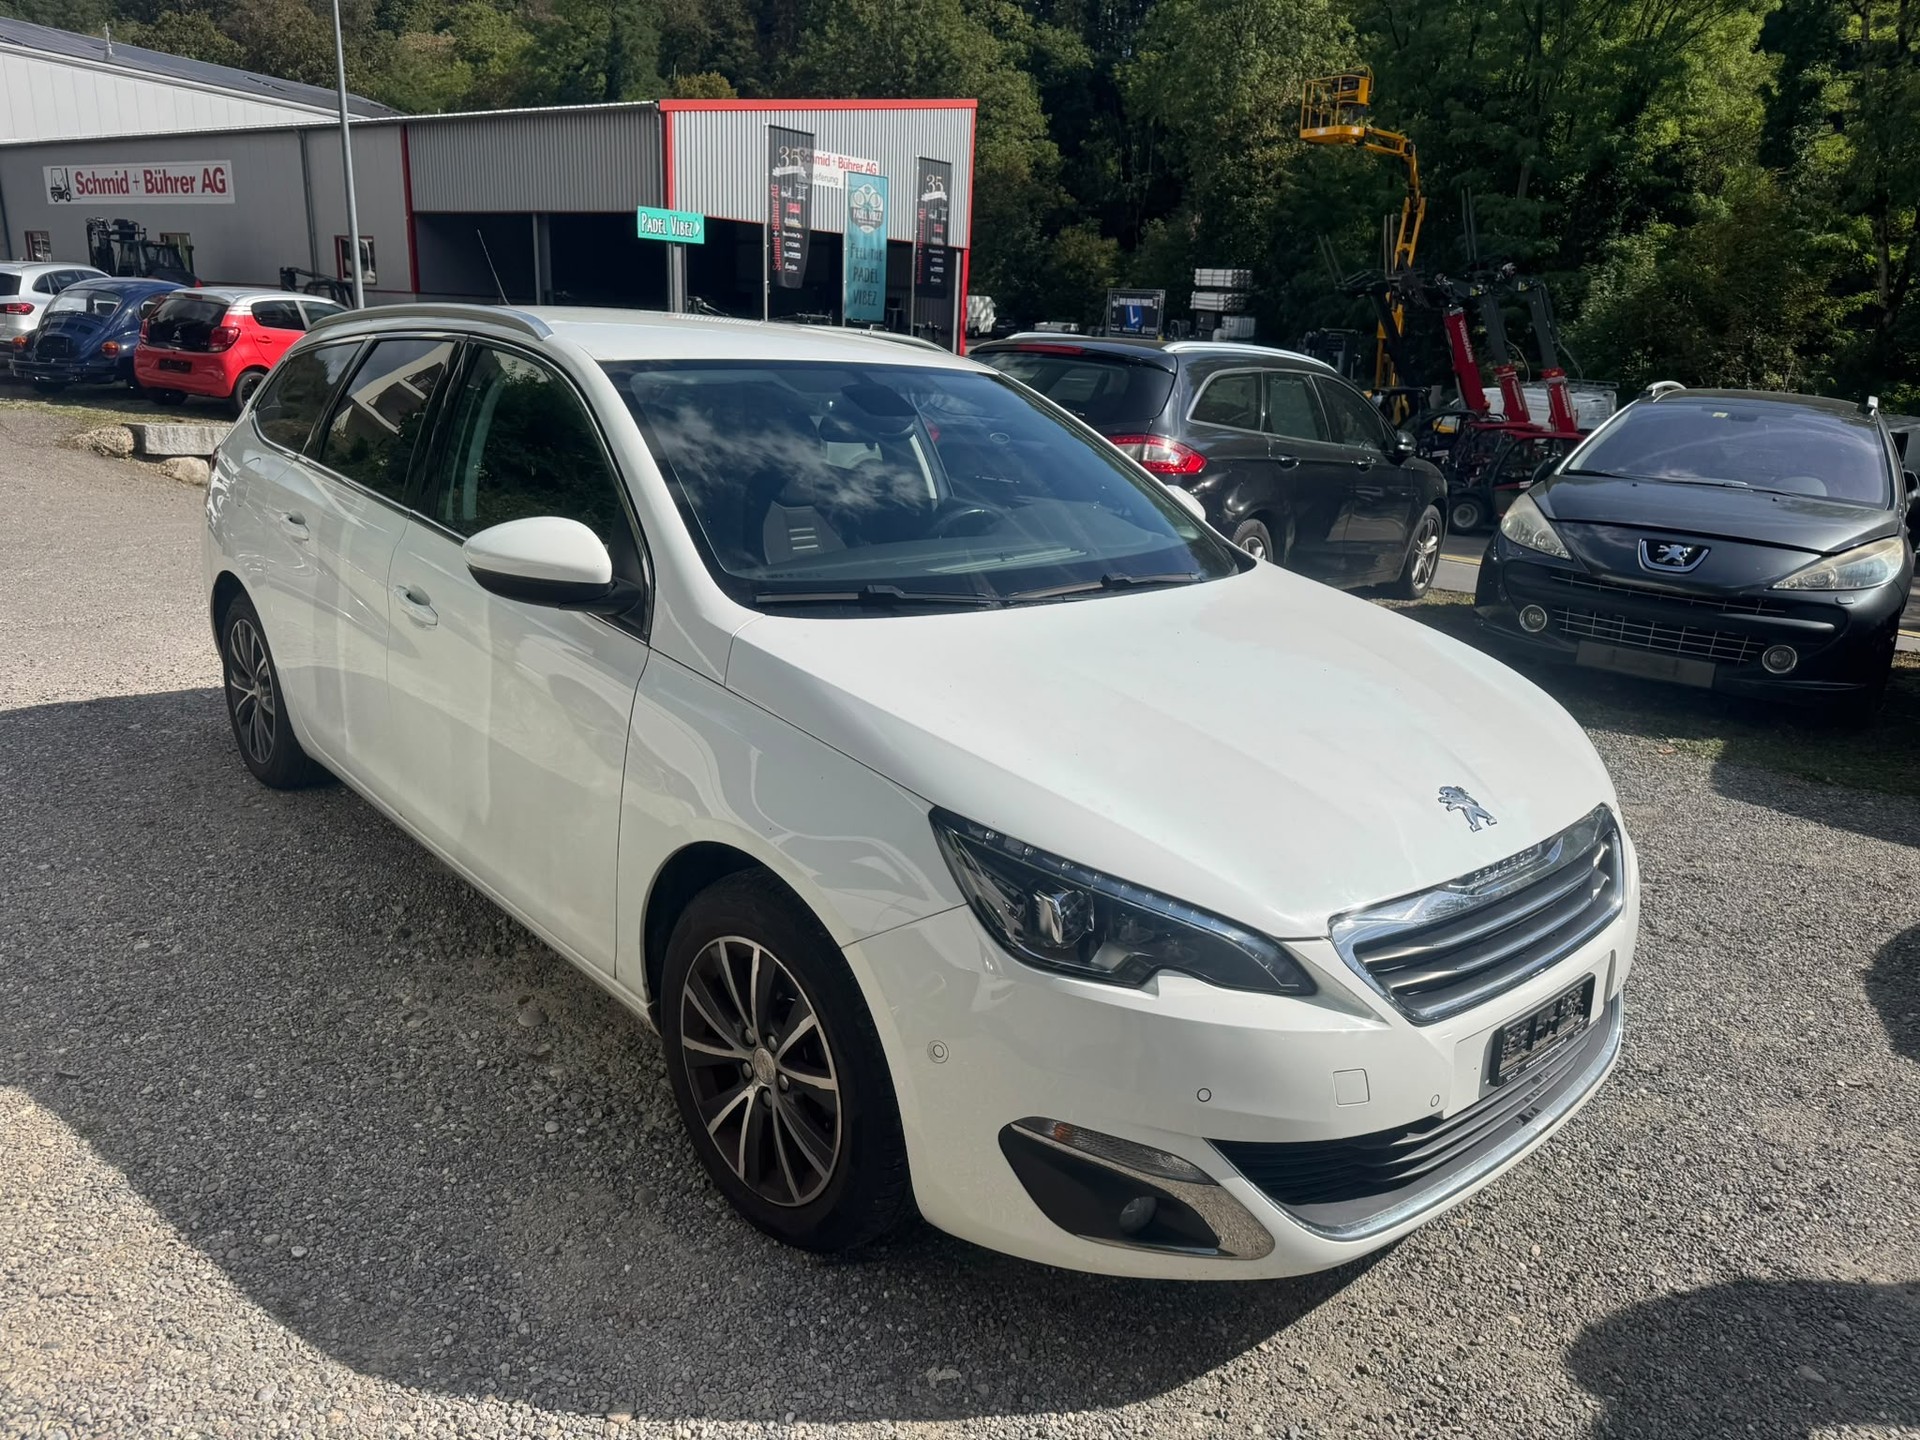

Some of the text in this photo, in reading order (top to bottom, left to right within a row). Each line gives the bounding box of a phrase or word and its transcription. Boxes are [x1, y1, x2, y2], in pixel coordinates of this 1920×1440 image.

[779, 146, 801, 167] 35
[838, 157, 864, 171] Bührer
[866, 162, 877, 174] AG
[75, 167, 227, 195] Schmid + Bührer AG
[926, 174, 944, 192] 35
[641, 212, 667, 235] PADEL
